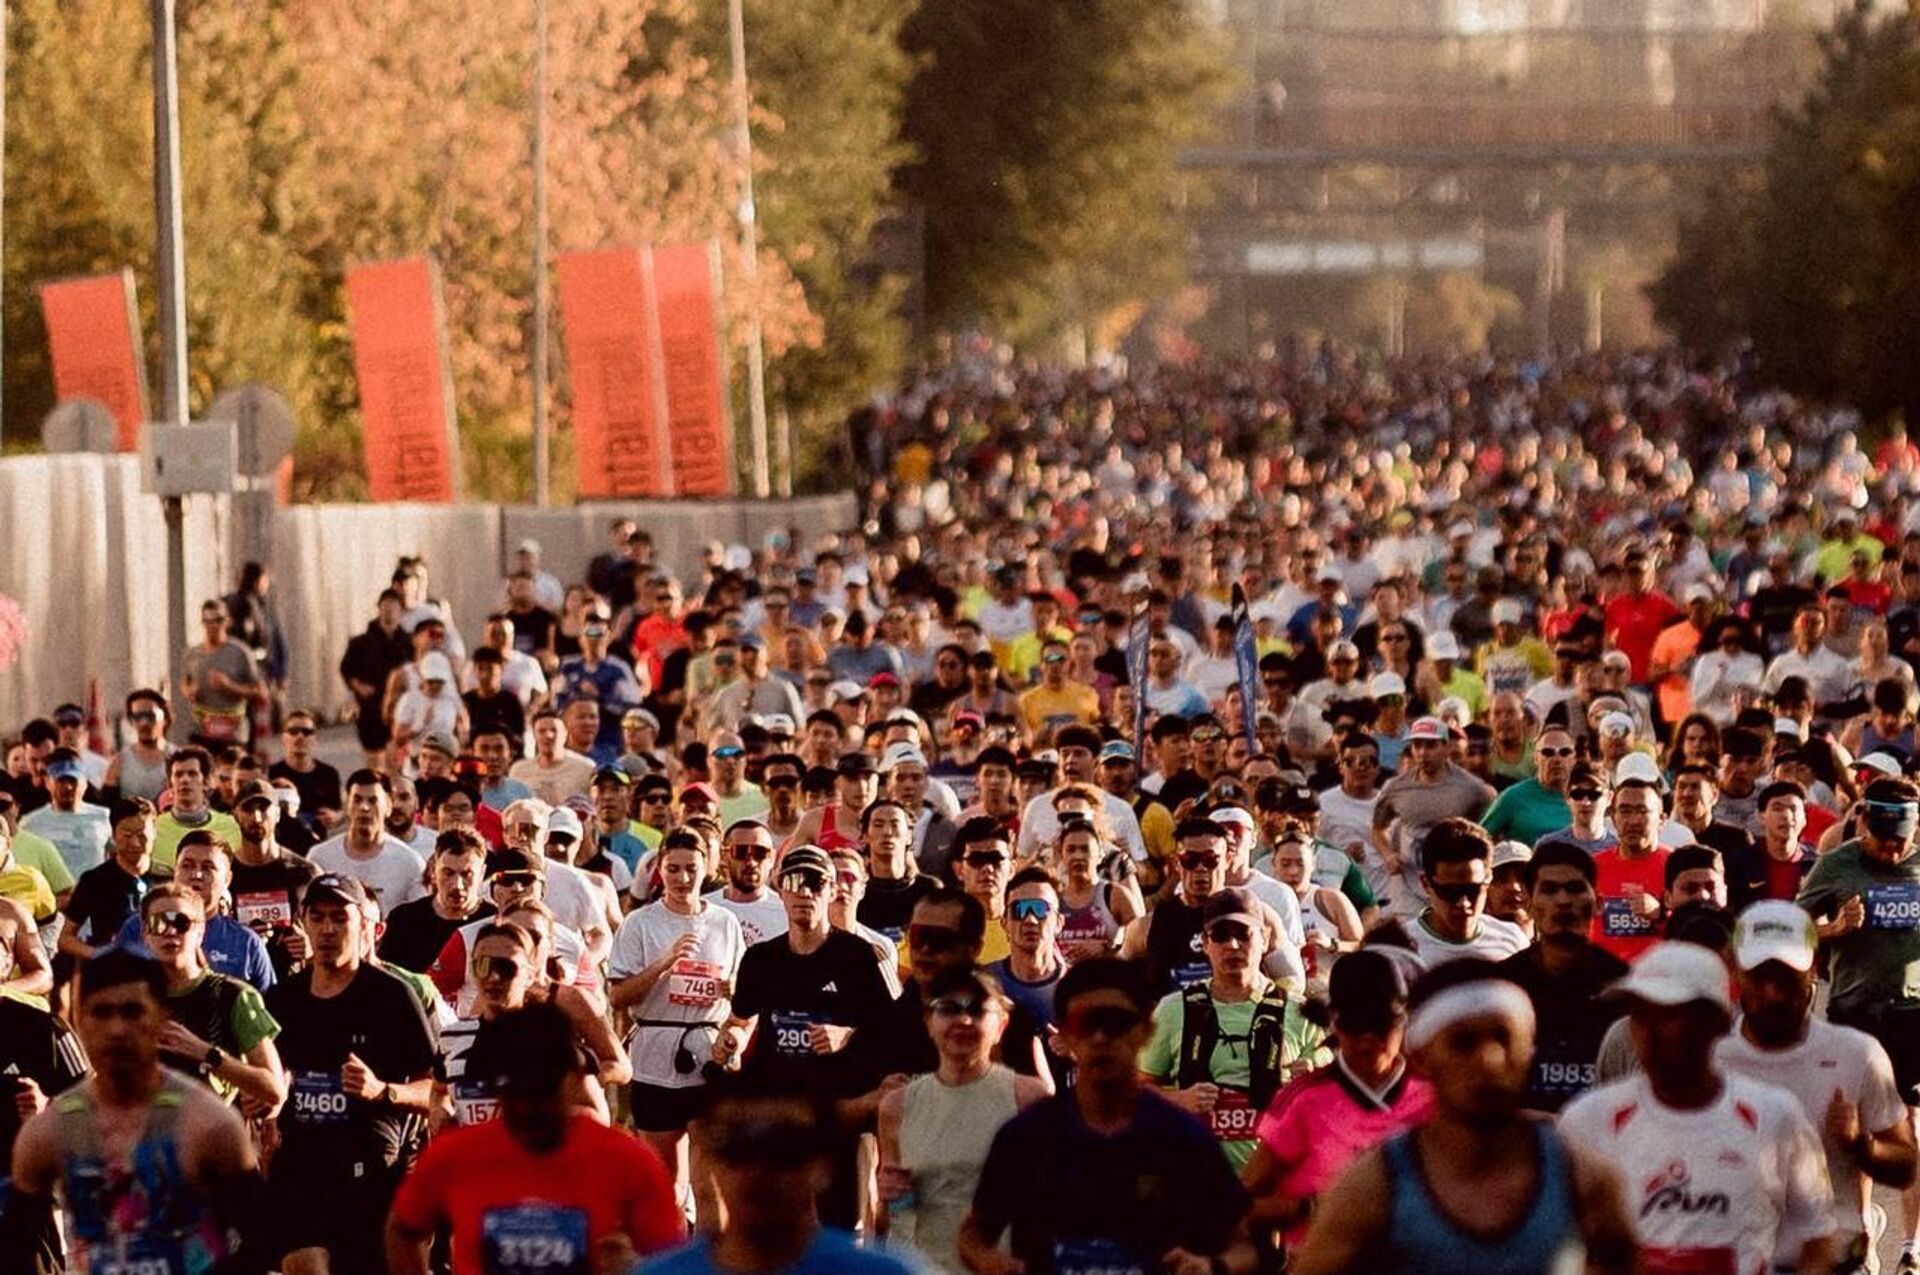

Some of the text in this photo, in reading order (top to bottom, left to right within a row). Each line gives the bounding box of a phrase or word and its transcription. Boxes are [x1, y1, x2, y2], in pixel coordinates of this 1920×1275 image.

[1874, 901, 1920, 918] 4208
[684, 979, 715, 996] 748
[777, 1028, 811, 1047] 290
[1540, 1063, 1596, 1083] 1983
[294, 1092, 346, 1113] 3460
[466, 1103, 500, 1122] 157
[1210, 1109, 1257, 1129] 1387
[498, 1238, 573, 1268] 3124
